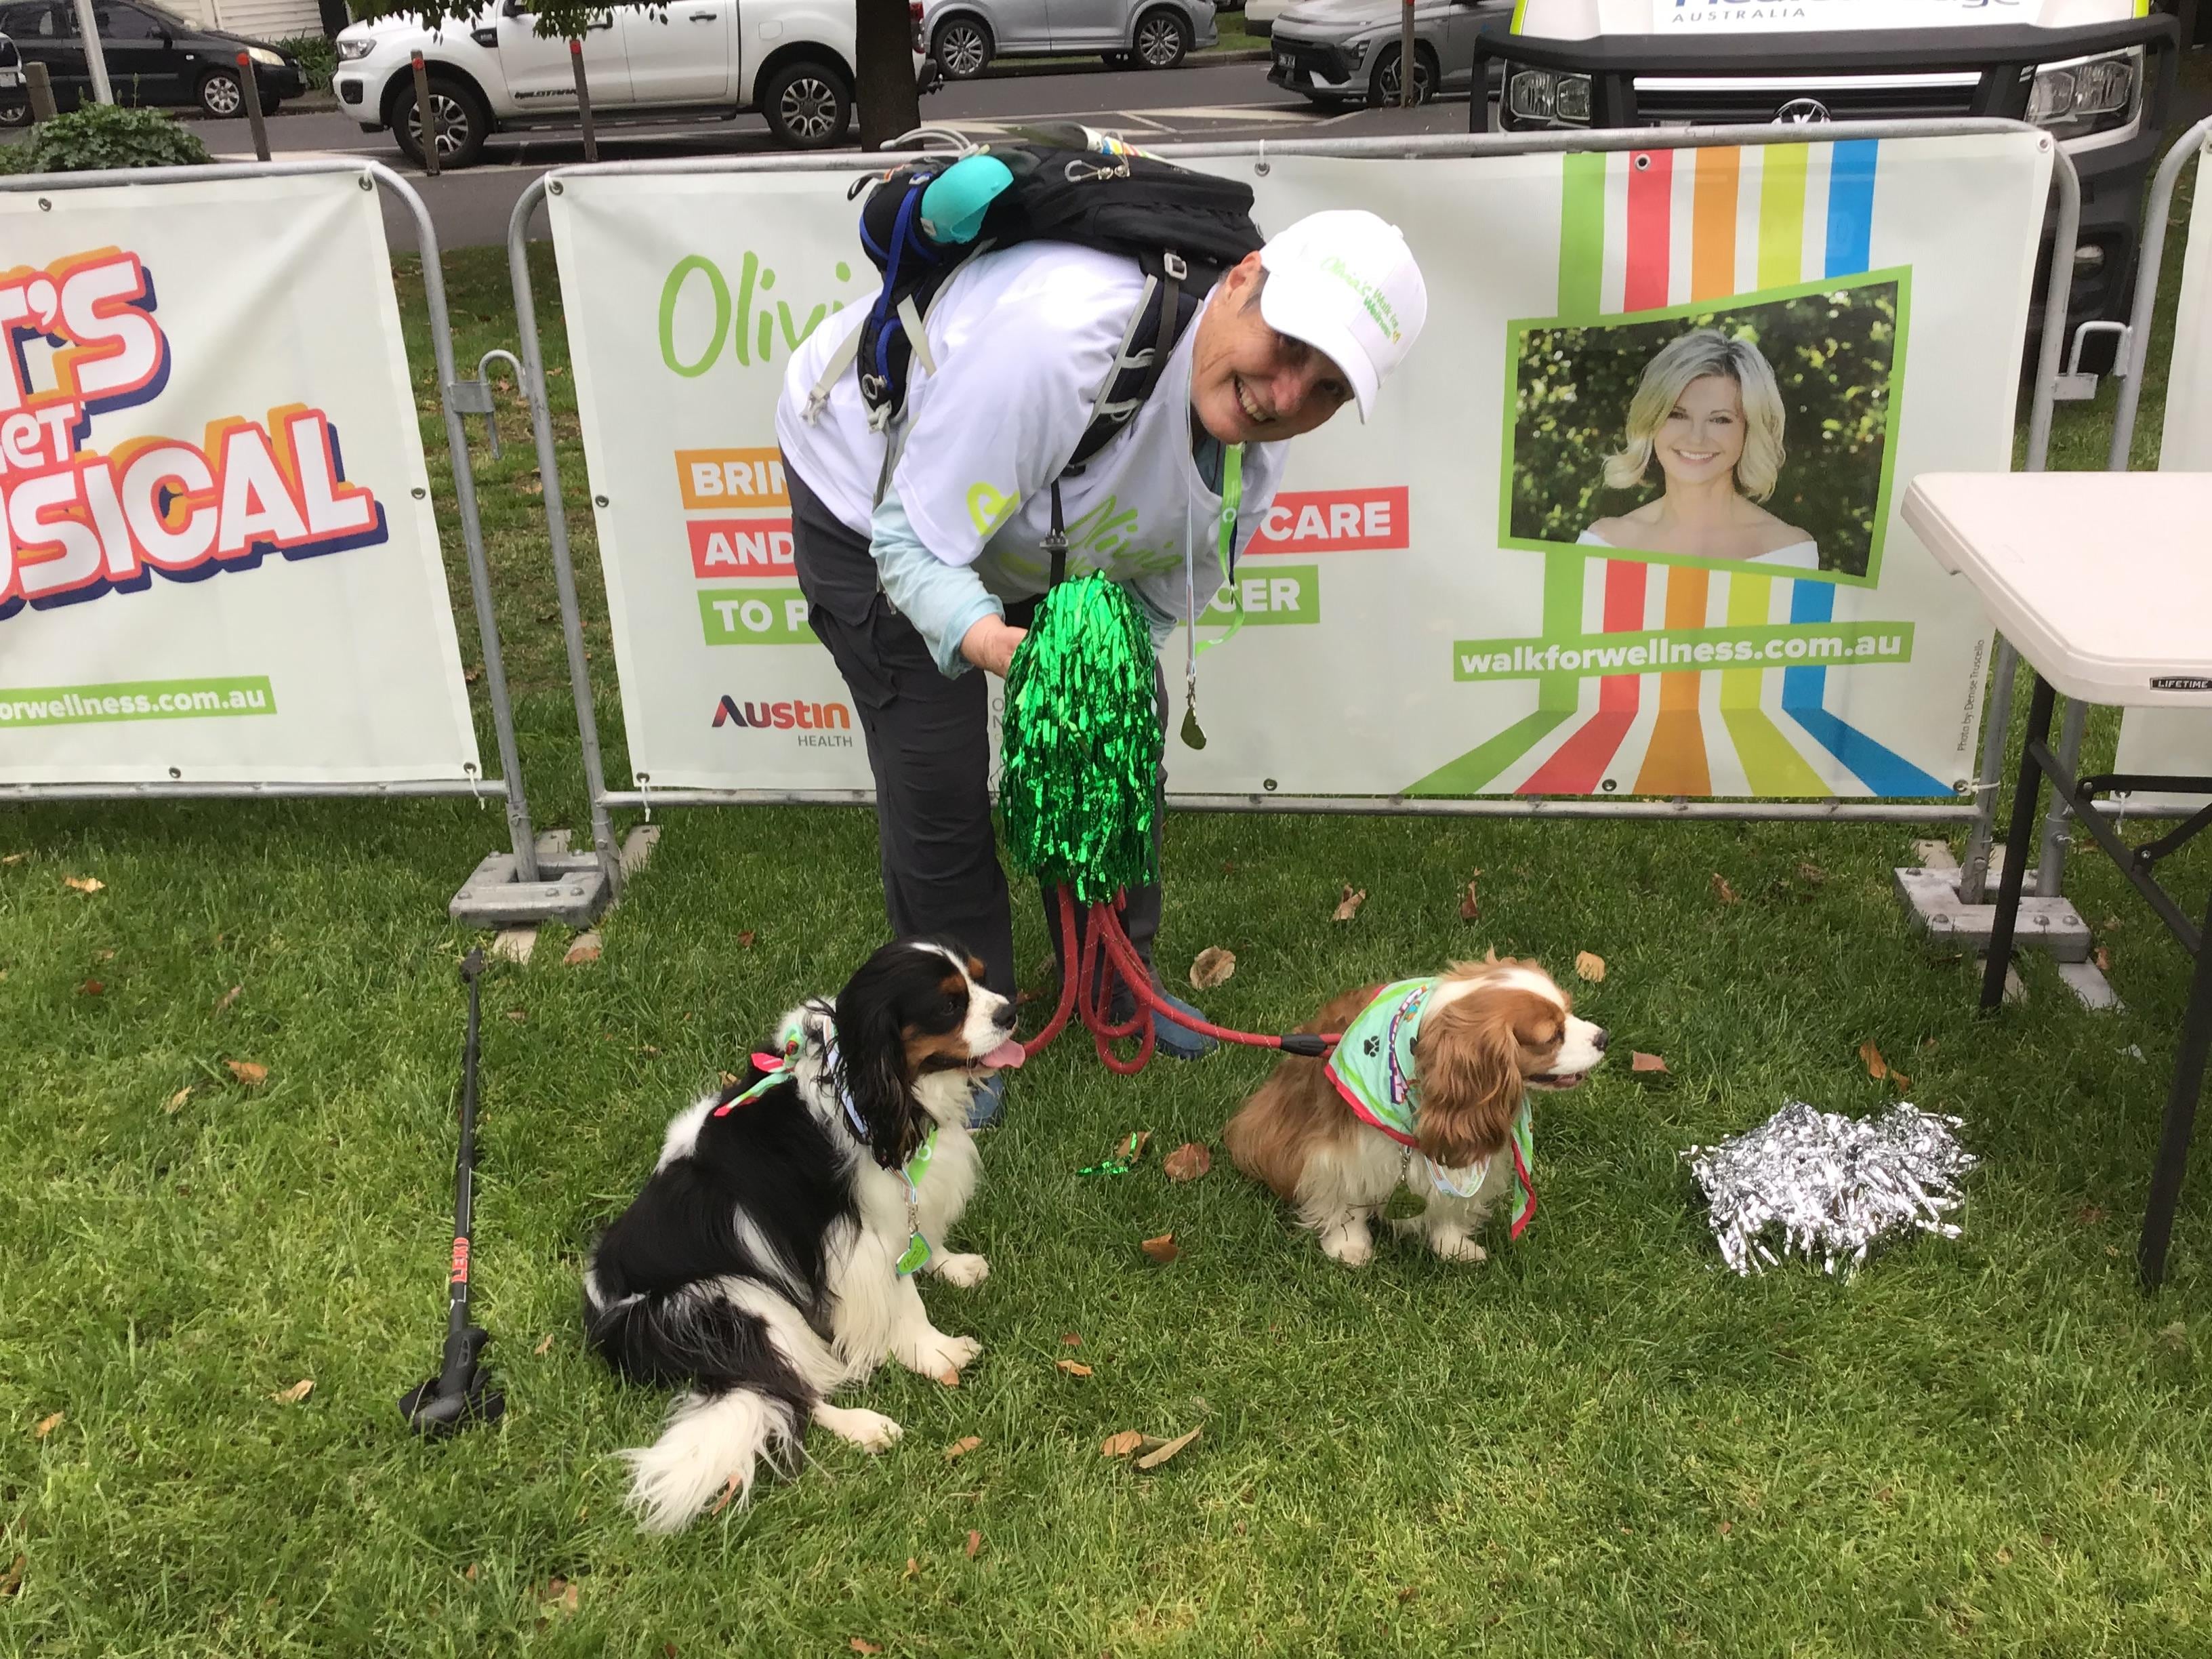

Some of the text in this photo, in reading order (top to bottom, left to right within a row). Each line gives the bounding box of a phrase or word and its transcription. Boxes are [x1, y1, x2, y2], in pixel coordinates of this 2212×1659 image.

[1672, 8, 1805, 23] AUSTRALIA
[659, 250, 851, 377] Oliv
[0, 411, 377, 599] SICAL
[1260, 501, 1391, 541] CARE
[704, 531, 795, 566] AND
[712, 600, 773, 632] TO
[1460, 633, 1902, 674] walkforwellness.com.au
[1969, 639, 1984, 679] Truscello
[1964, 680, 1978, 710] Denise
[2158, 680, 2209, 689] LIFETIME
[712, 695, 851, 730] Austin
[798, 734, 853, 747] HEALTH
[1957, 726, 1969, 752] Photo
[451, 1237, 469, 1283] LEKI
